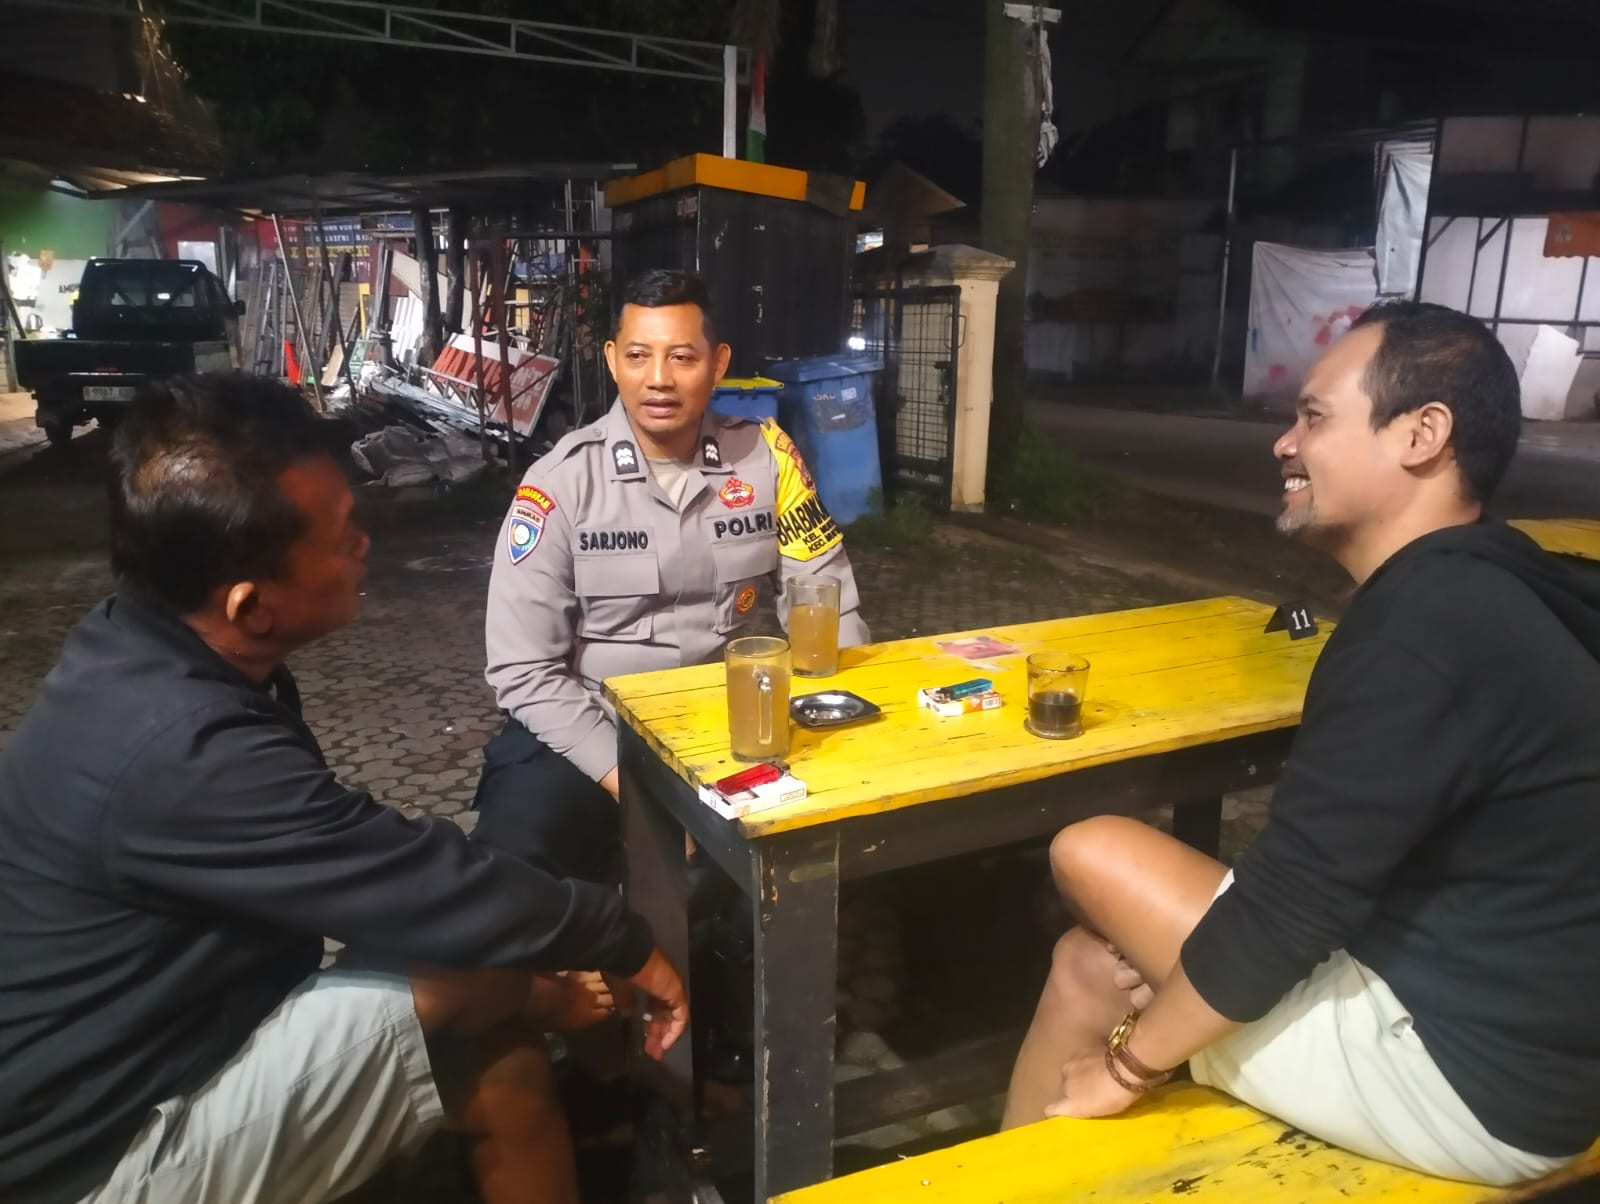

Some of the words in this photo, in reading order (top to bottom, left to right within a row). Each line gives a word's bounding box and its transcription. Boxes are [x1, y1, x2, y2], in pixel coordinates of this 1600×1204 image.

[713, 512, 773, 539] POLRI
[580, 531, 649, 551] SARJONO
[1291, 608, 1311, 630] 11
